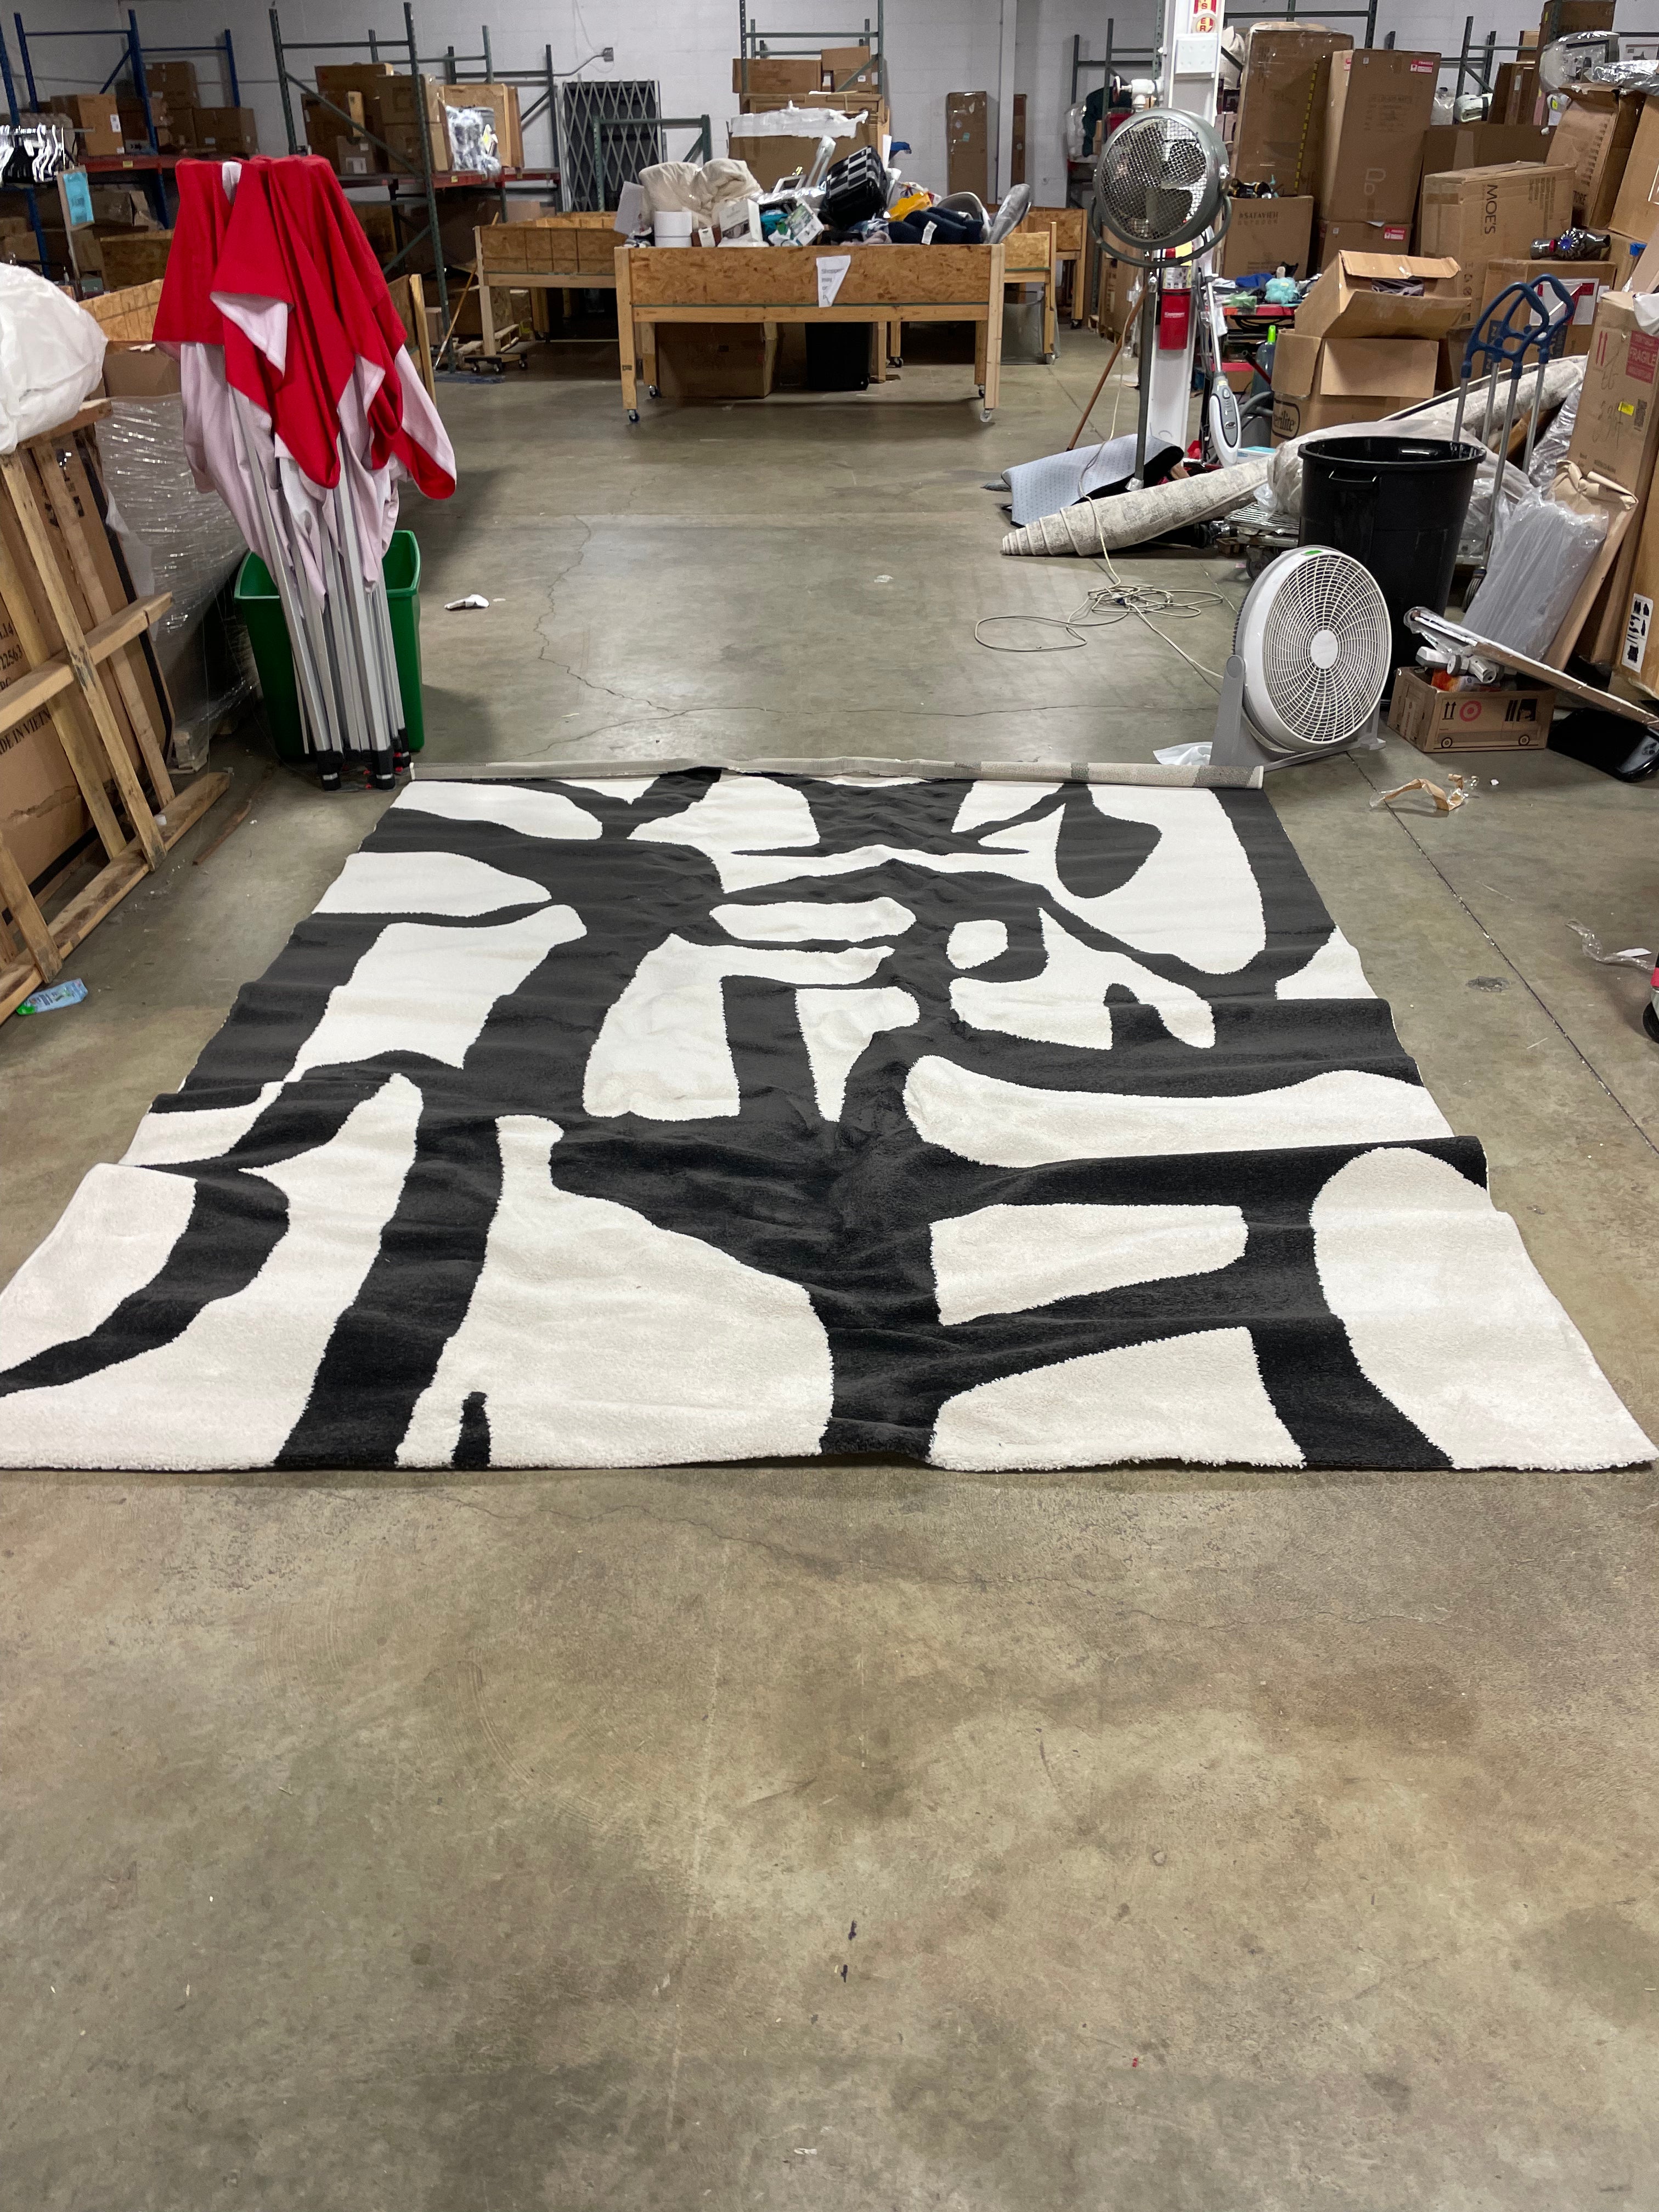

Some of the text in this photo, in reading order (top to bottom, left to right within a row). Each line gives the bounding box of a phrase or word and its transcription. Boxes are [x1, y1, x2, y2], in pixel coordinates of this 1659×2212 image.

[1485, 184, 1498, 235] MOE'S
[1573, 190, 1587, 205] TORE
[1629, 346, 1656, 367] FRAGILE
[1273, 410, 1295, 432] erilite
[0, 644, 23, 670] 22563
[12, 725, 25, 744] IN
[23, 709, 52, 734] VIETN
